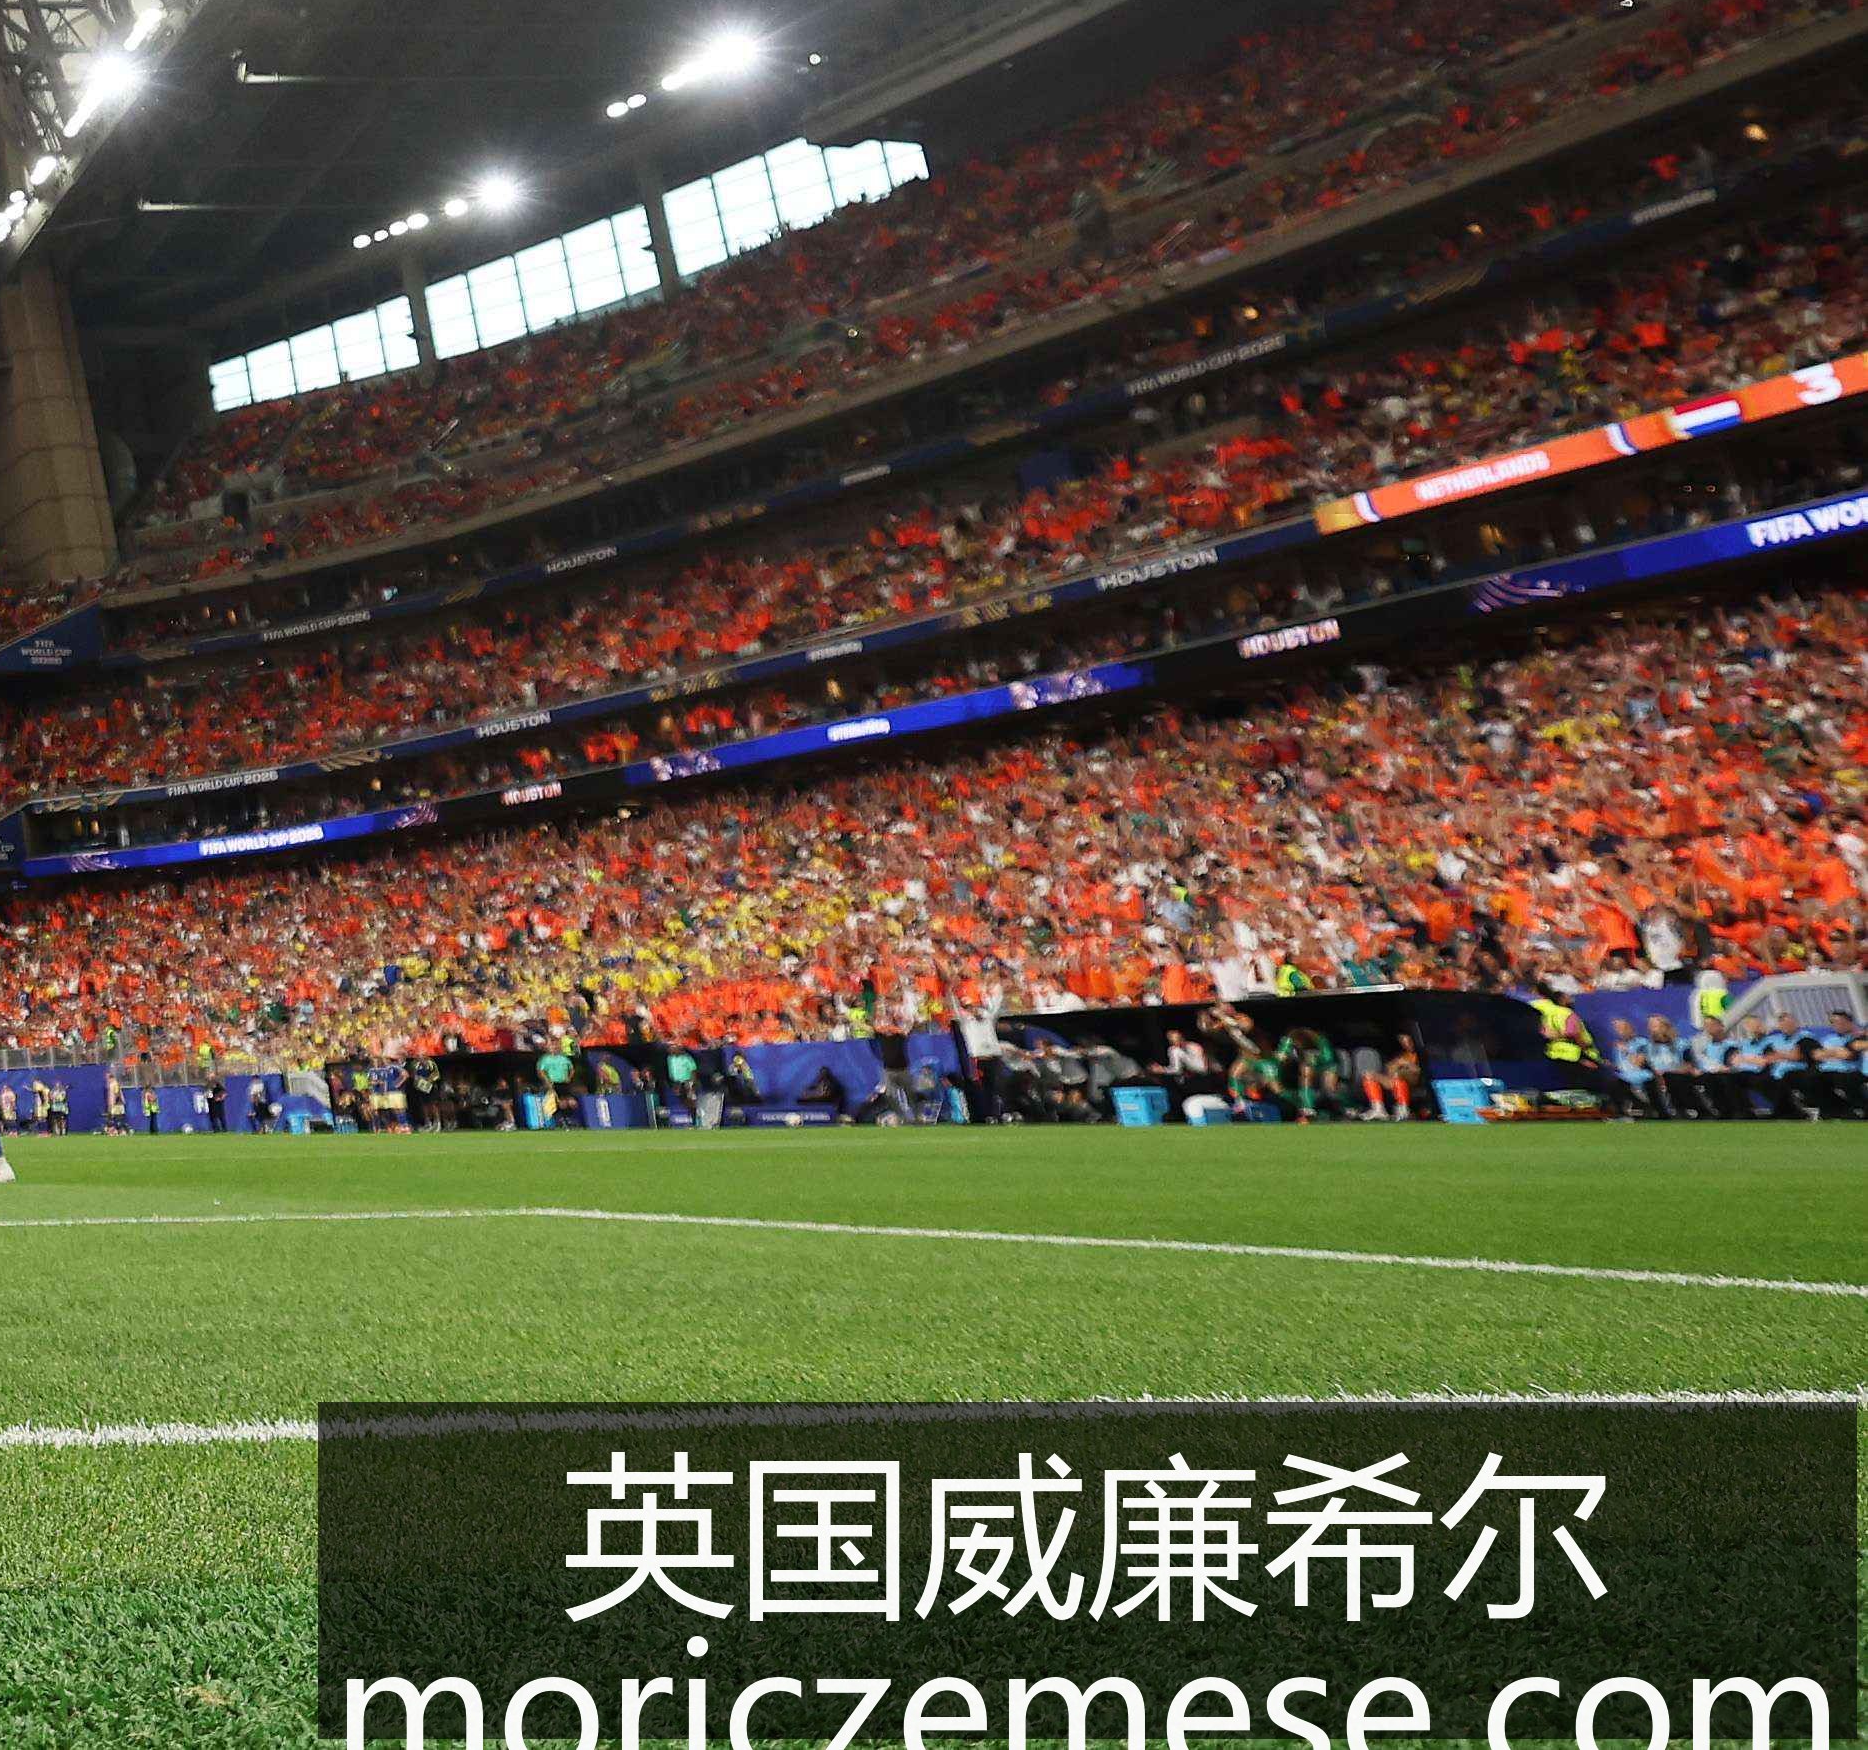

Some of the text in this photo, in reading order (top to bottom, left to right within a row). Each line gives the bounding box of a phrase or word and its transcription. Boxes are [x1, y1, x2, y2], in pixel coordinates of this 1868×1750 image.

[1790, 362, 1843, 406] 3
[1745, 514, 1815, 548] FIFA
[476, 711, 552, 739] HOUSTON
[167, 785, 188, 797] FIFA
[189, 779, 222, 794] WORLD
[223, 776, 243, 789] CUP
